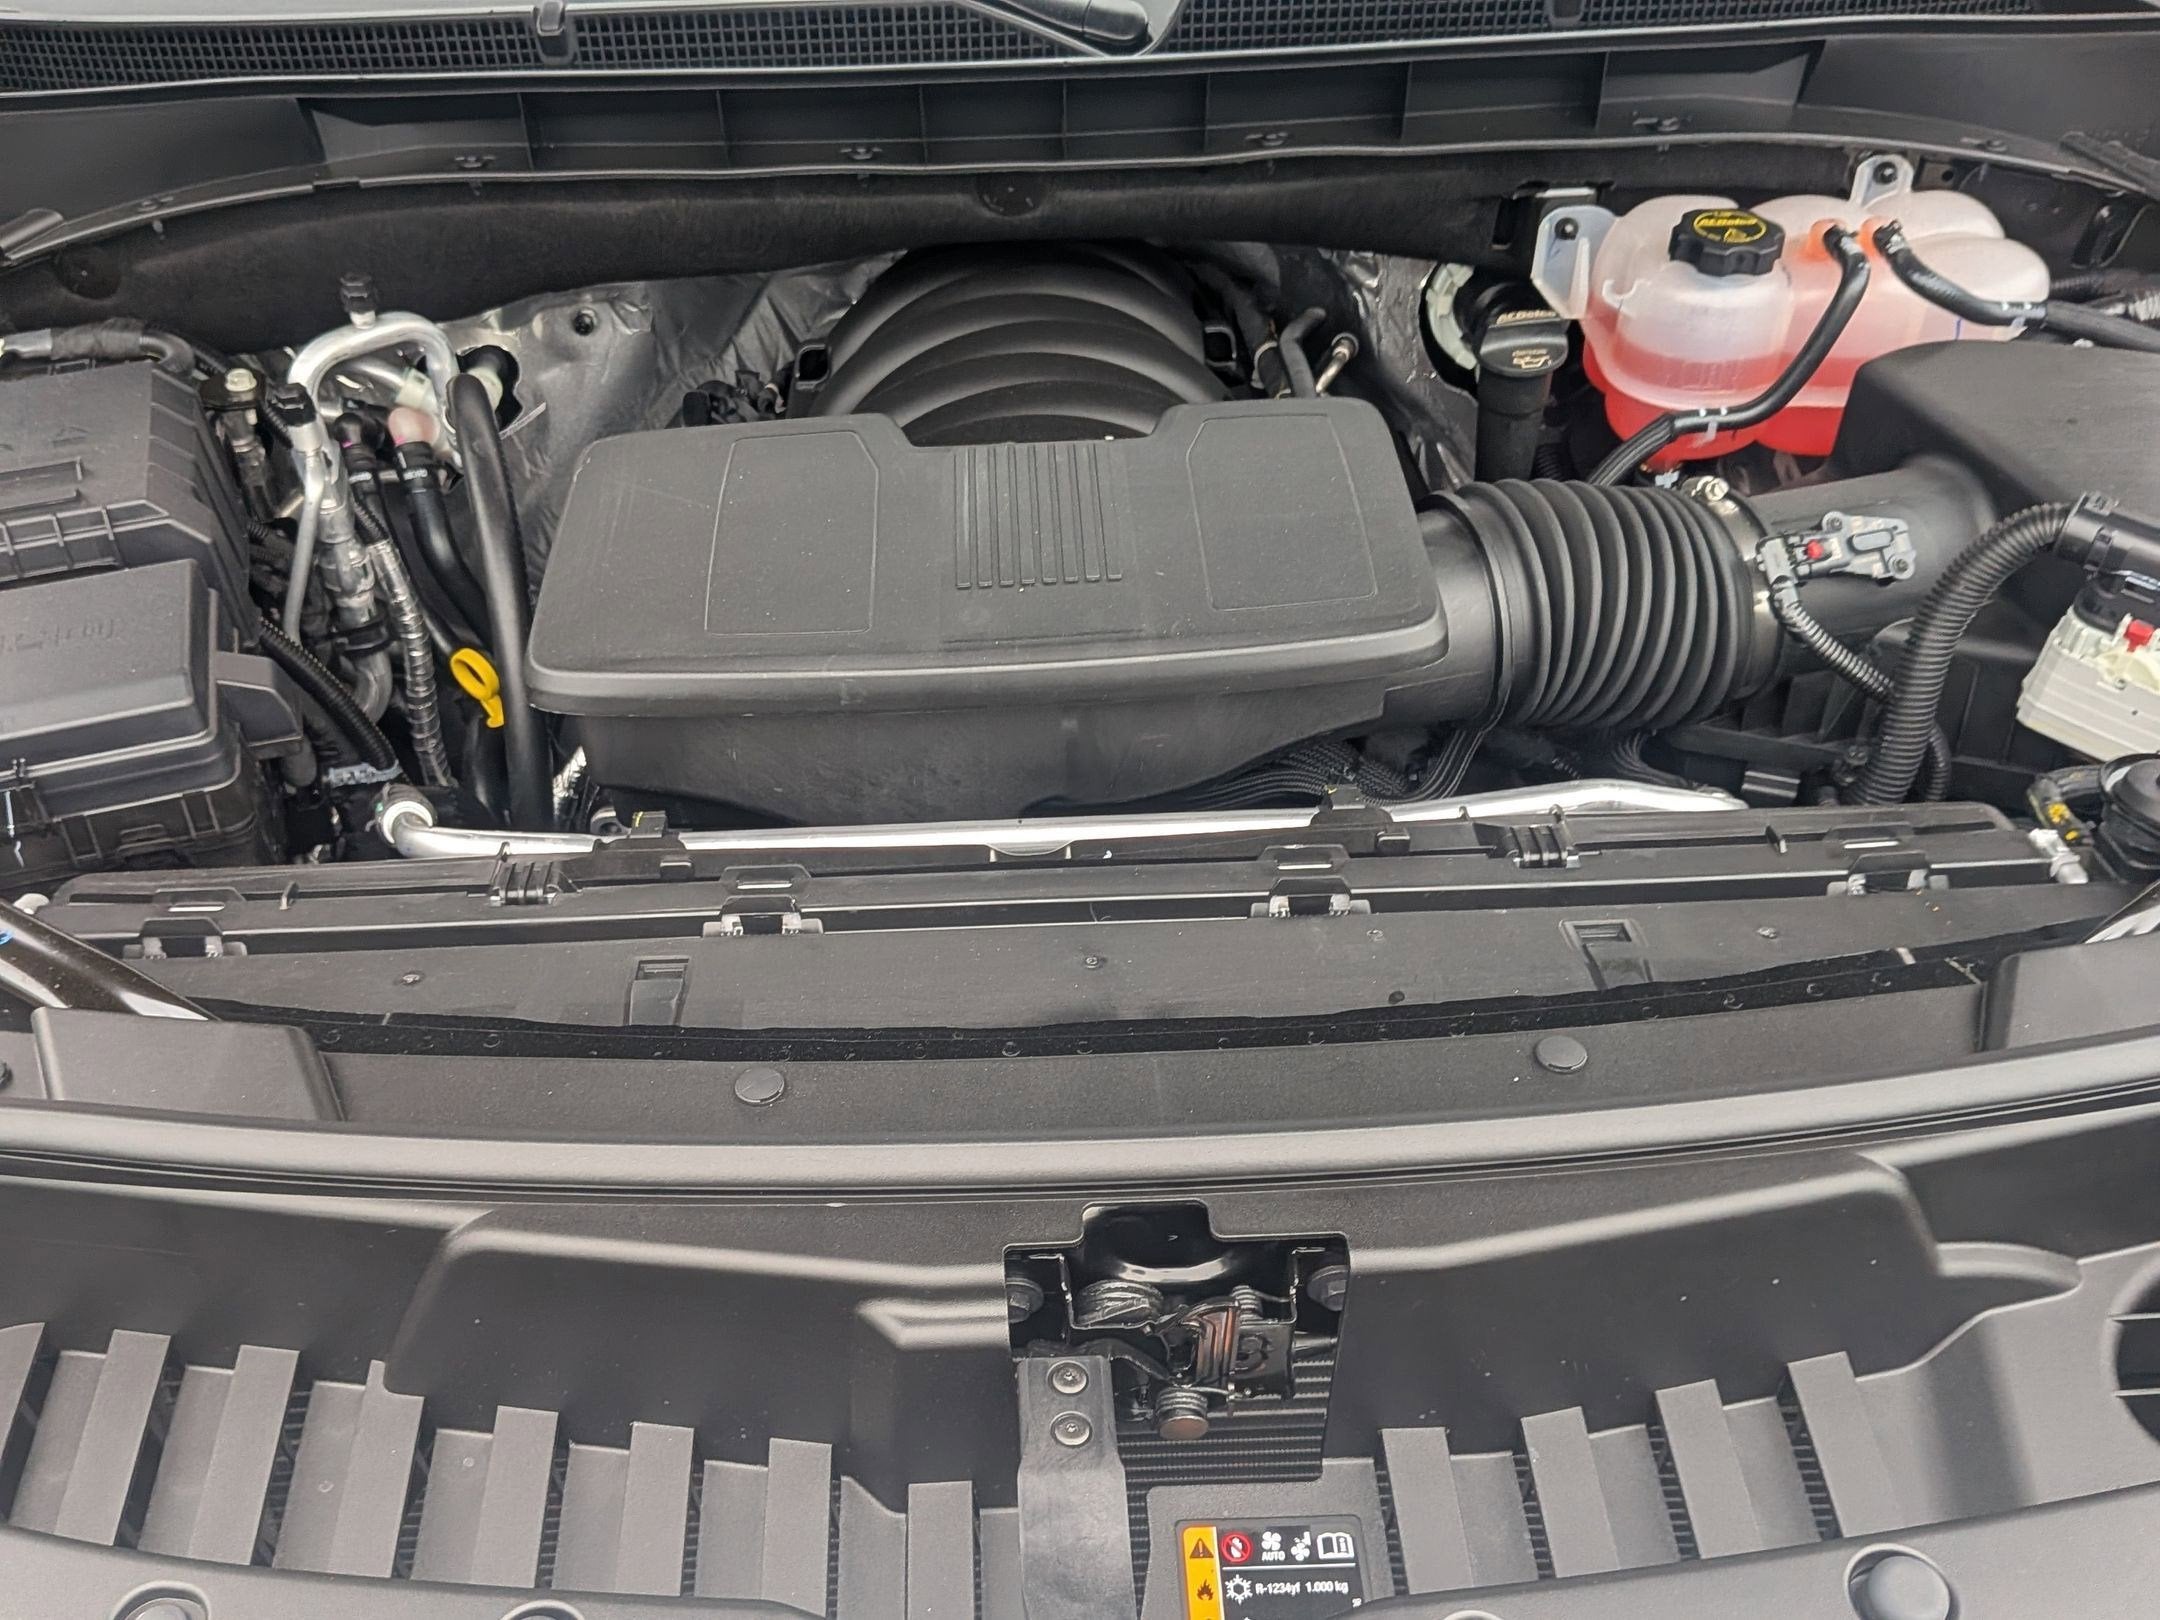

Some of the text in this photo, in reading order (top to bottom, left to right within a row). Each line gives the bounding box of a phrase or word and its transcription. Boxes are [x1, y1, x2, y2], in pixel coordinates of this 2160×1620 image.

[1261, 1551, 1286, 1562] AUTO
[1255, 1580, 1349, 1597] R-1234yf 1.000 kg
